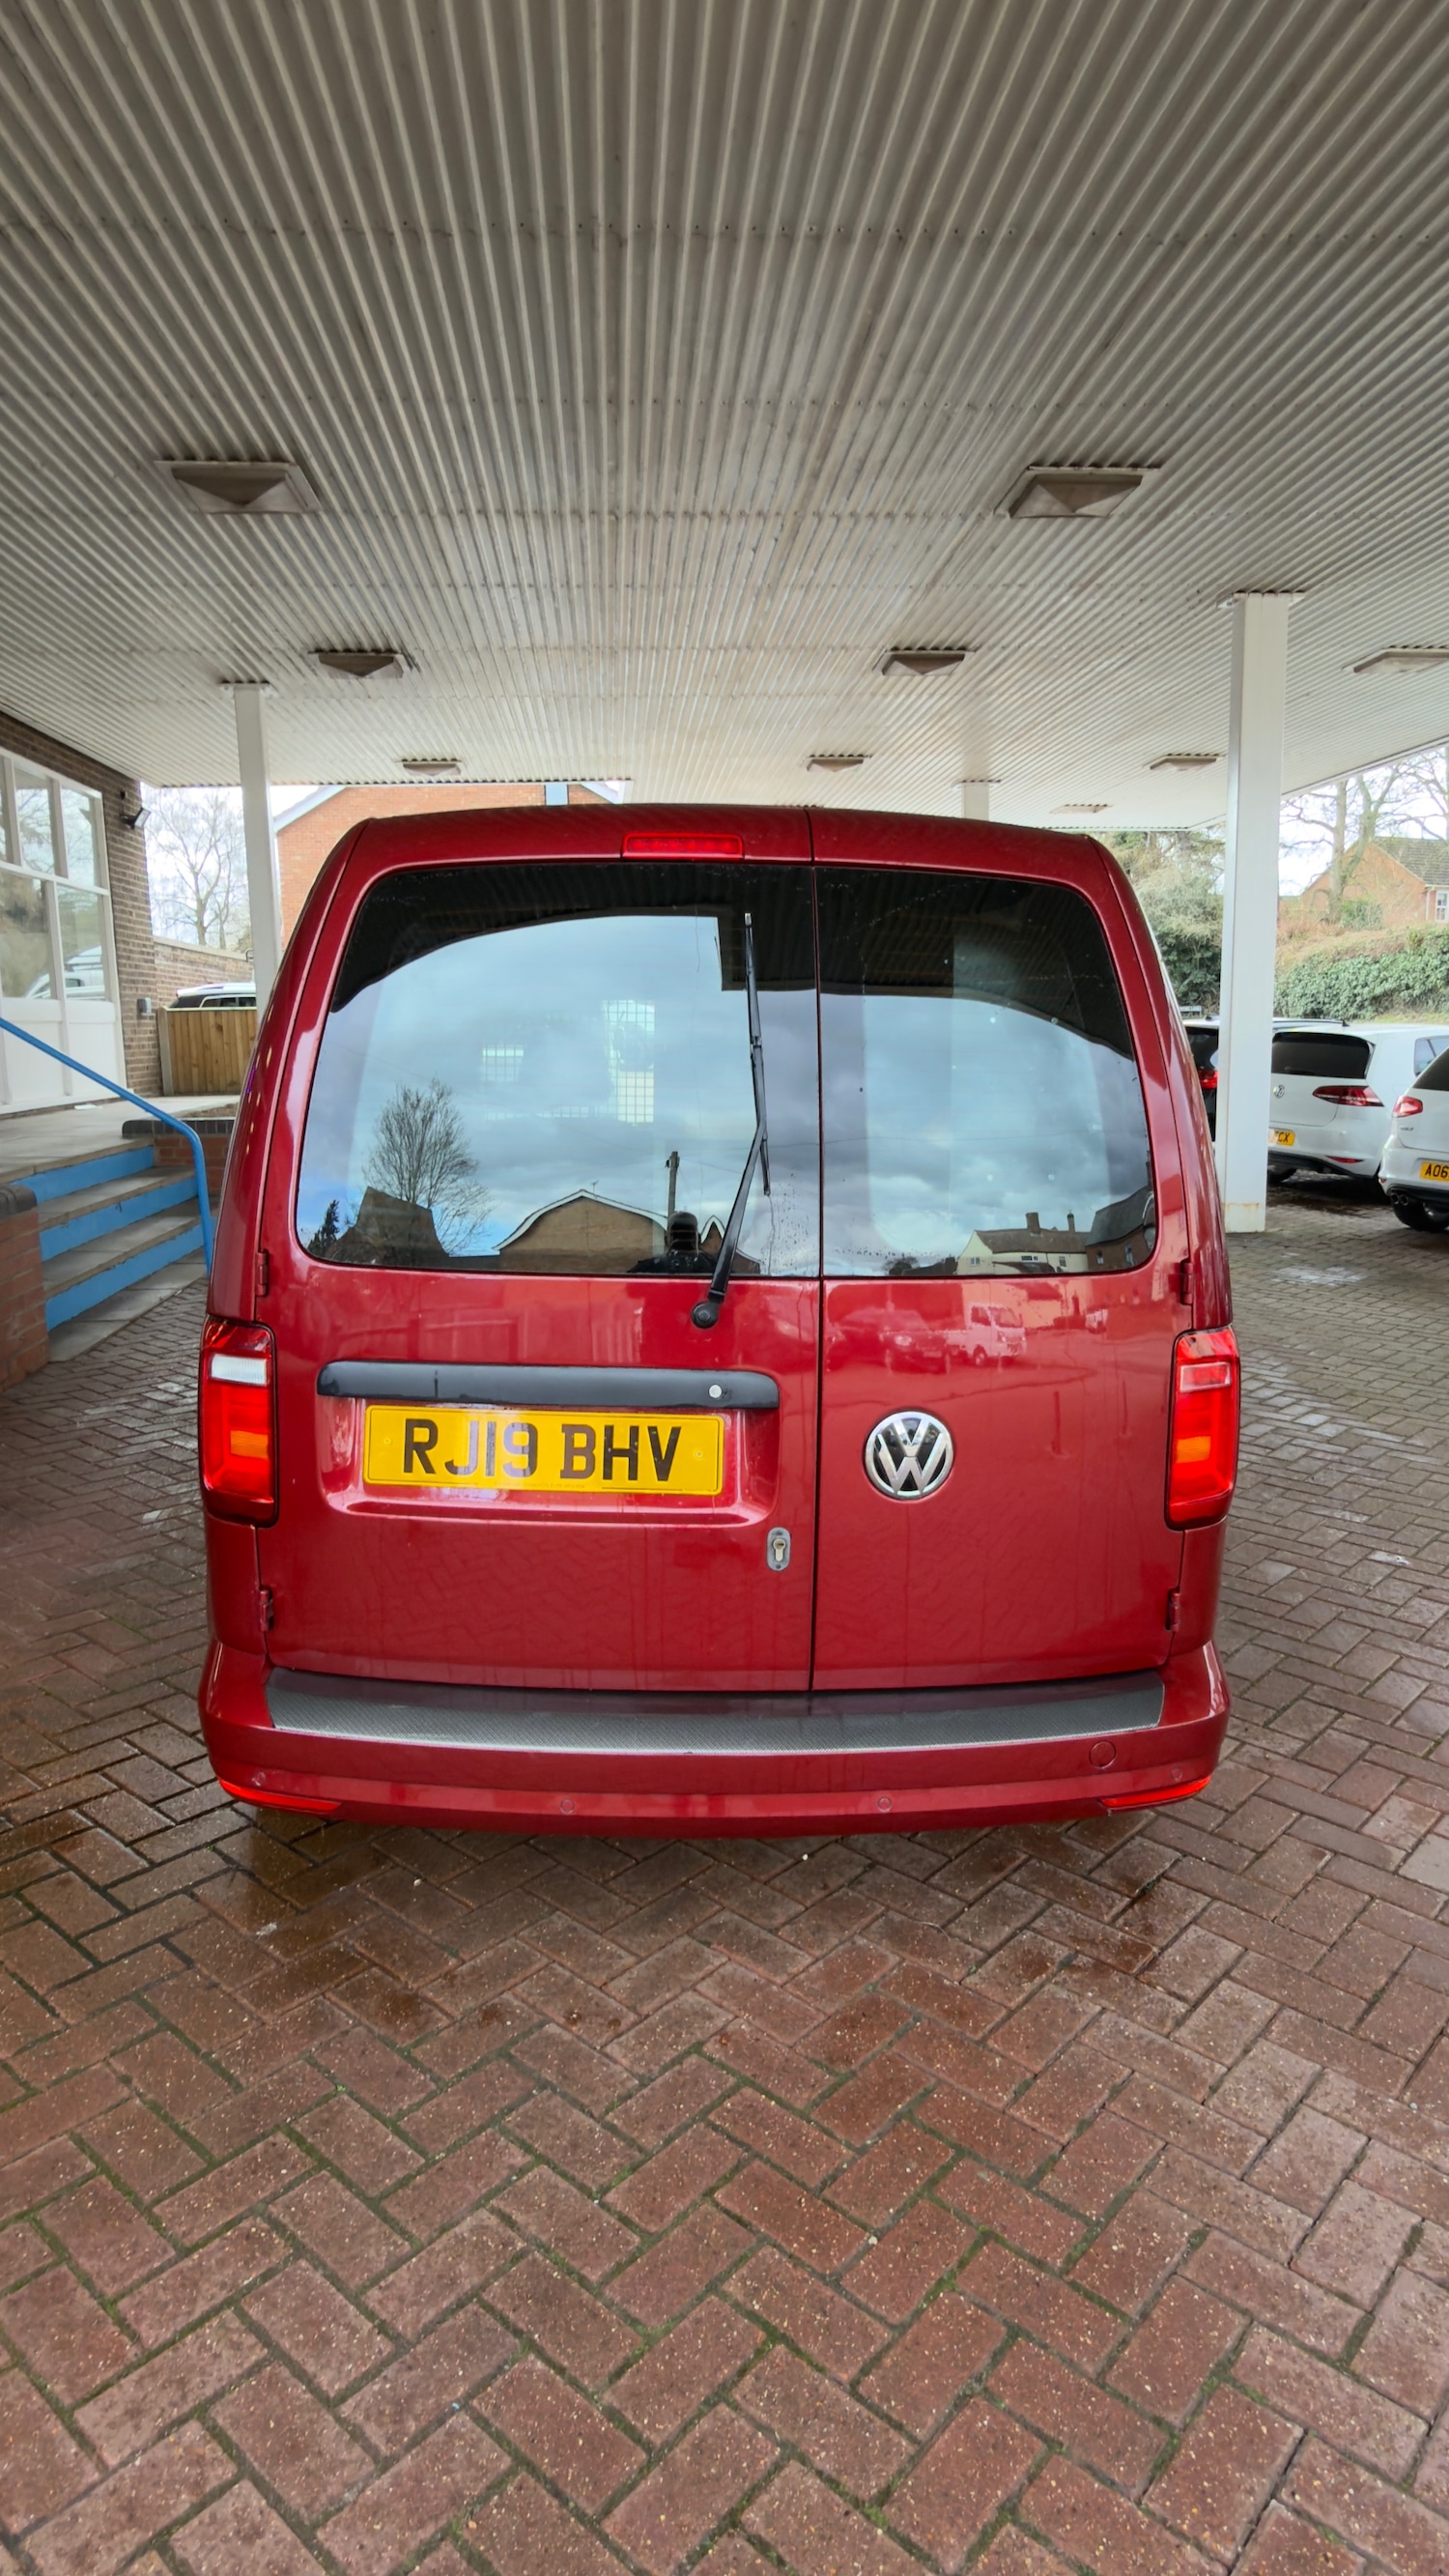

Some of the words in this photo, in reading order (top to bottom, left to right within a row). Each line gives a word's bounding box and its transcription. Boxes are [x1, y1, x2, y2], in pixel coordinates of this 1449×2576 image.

[1424, 1162, 1449, 1179] A06
[403, 1417, 538, 1477] RJ19
[559, 1423, 682, 1481] BHV
[865, 1411, 954, 1498] VW
